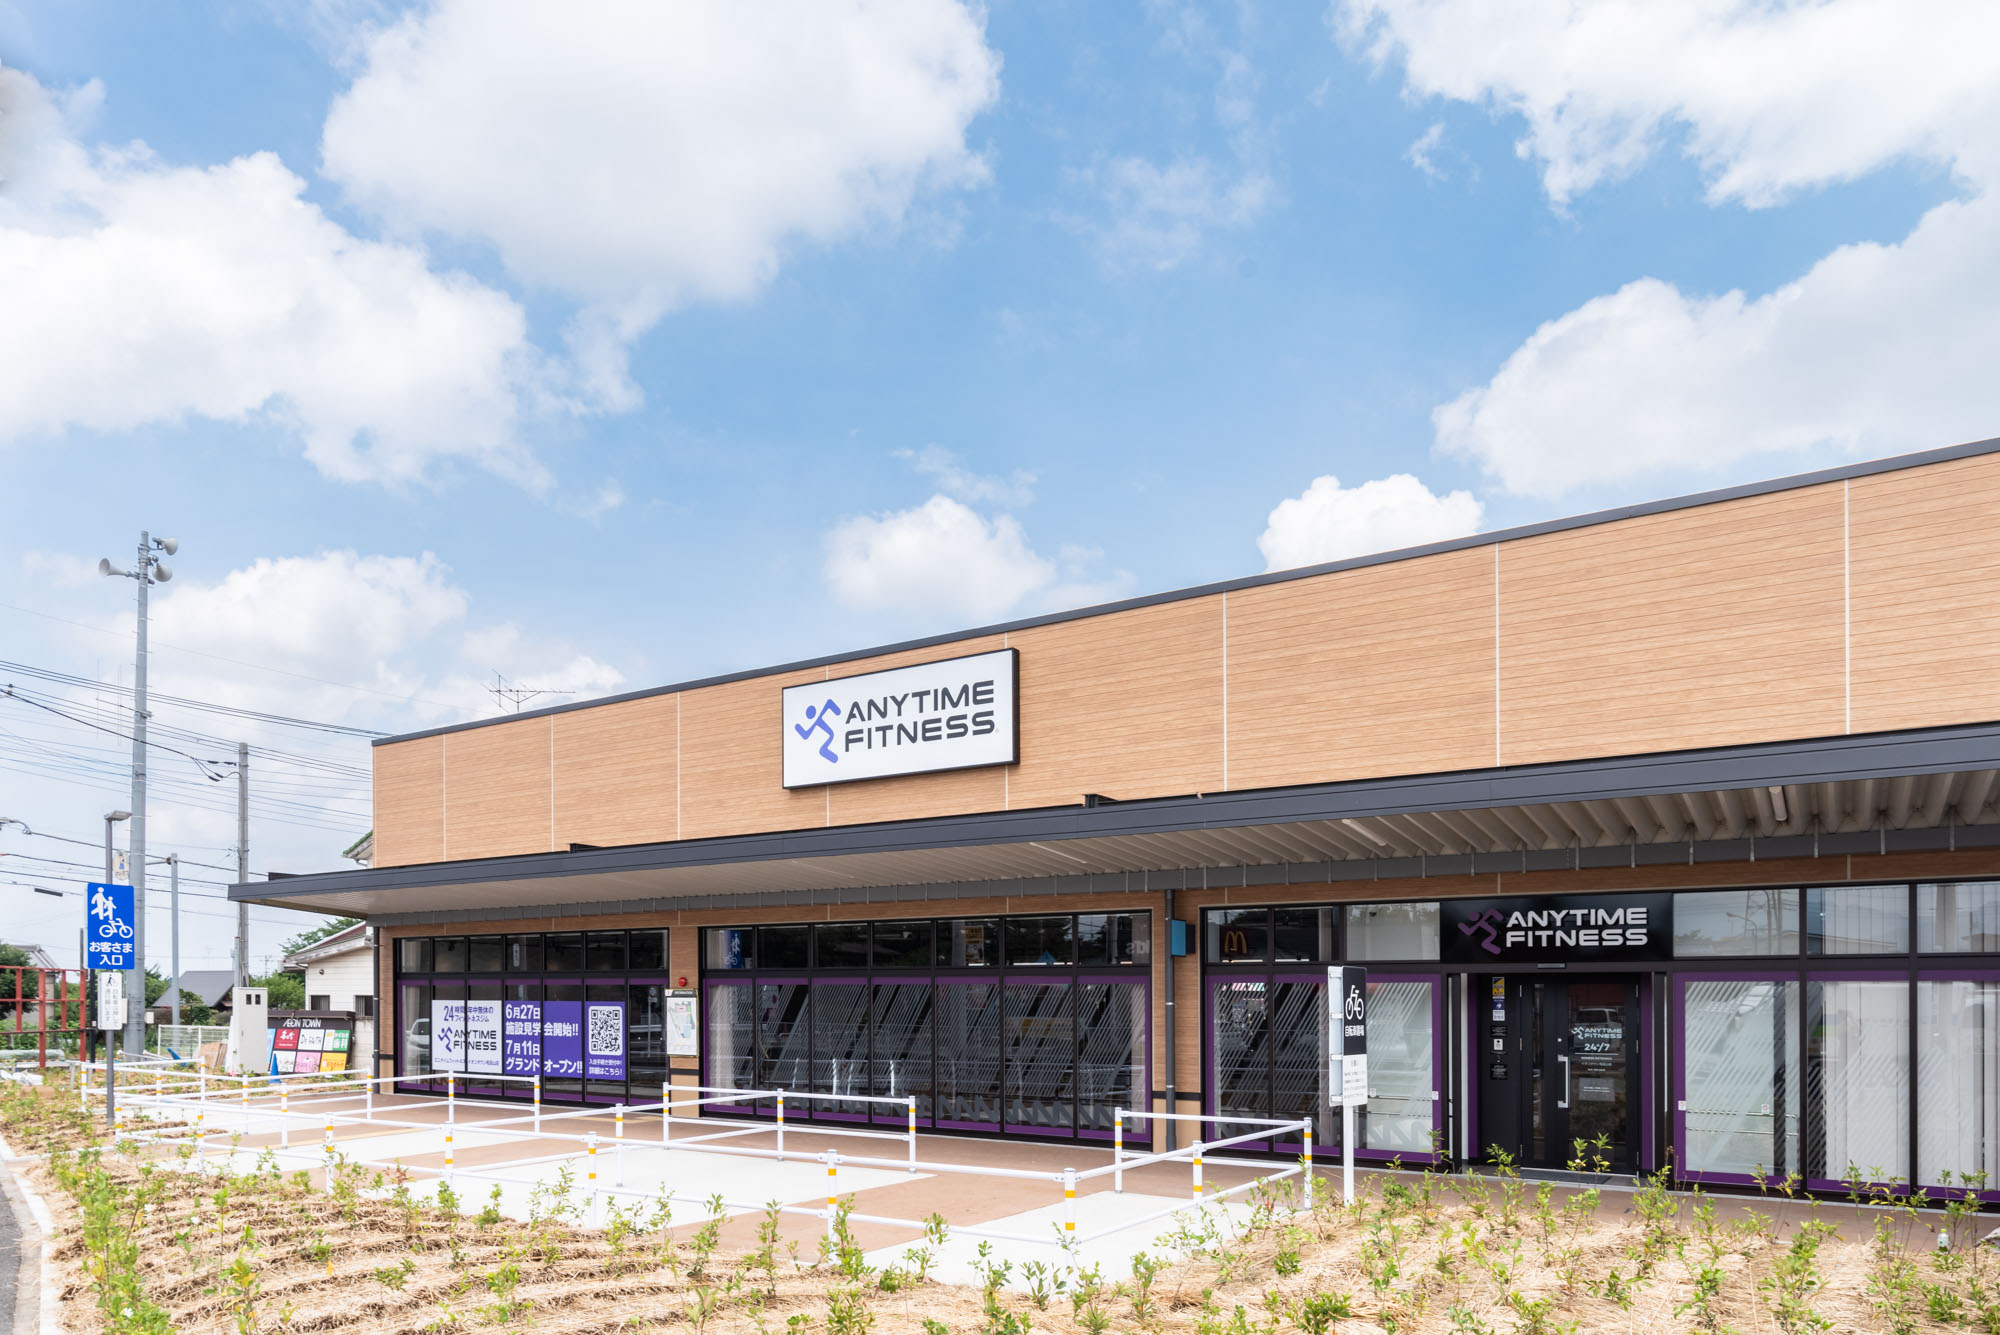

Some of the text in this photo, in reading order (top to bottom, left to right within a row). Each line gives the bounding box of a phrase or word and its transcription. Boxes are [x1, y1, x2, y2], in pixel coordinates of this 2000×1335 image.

[845, 680, 994, 724] ANYTIME
[844, 710, 995, 752] FITNESS
[1506, 907, 1648, 928] ANYTIME
[1505, 928, 1648, 948] FITNESS
[89, 942, 133, 953] お客さま
[99, 955, 123, 966] 入口
[443, 1005, 454, 1022] 24
[505, 1004, 541, 1020] 6月27日
[302, 1019, 322, 1028] TOWN
[505, 1039, 540, 1056] 7月11日
